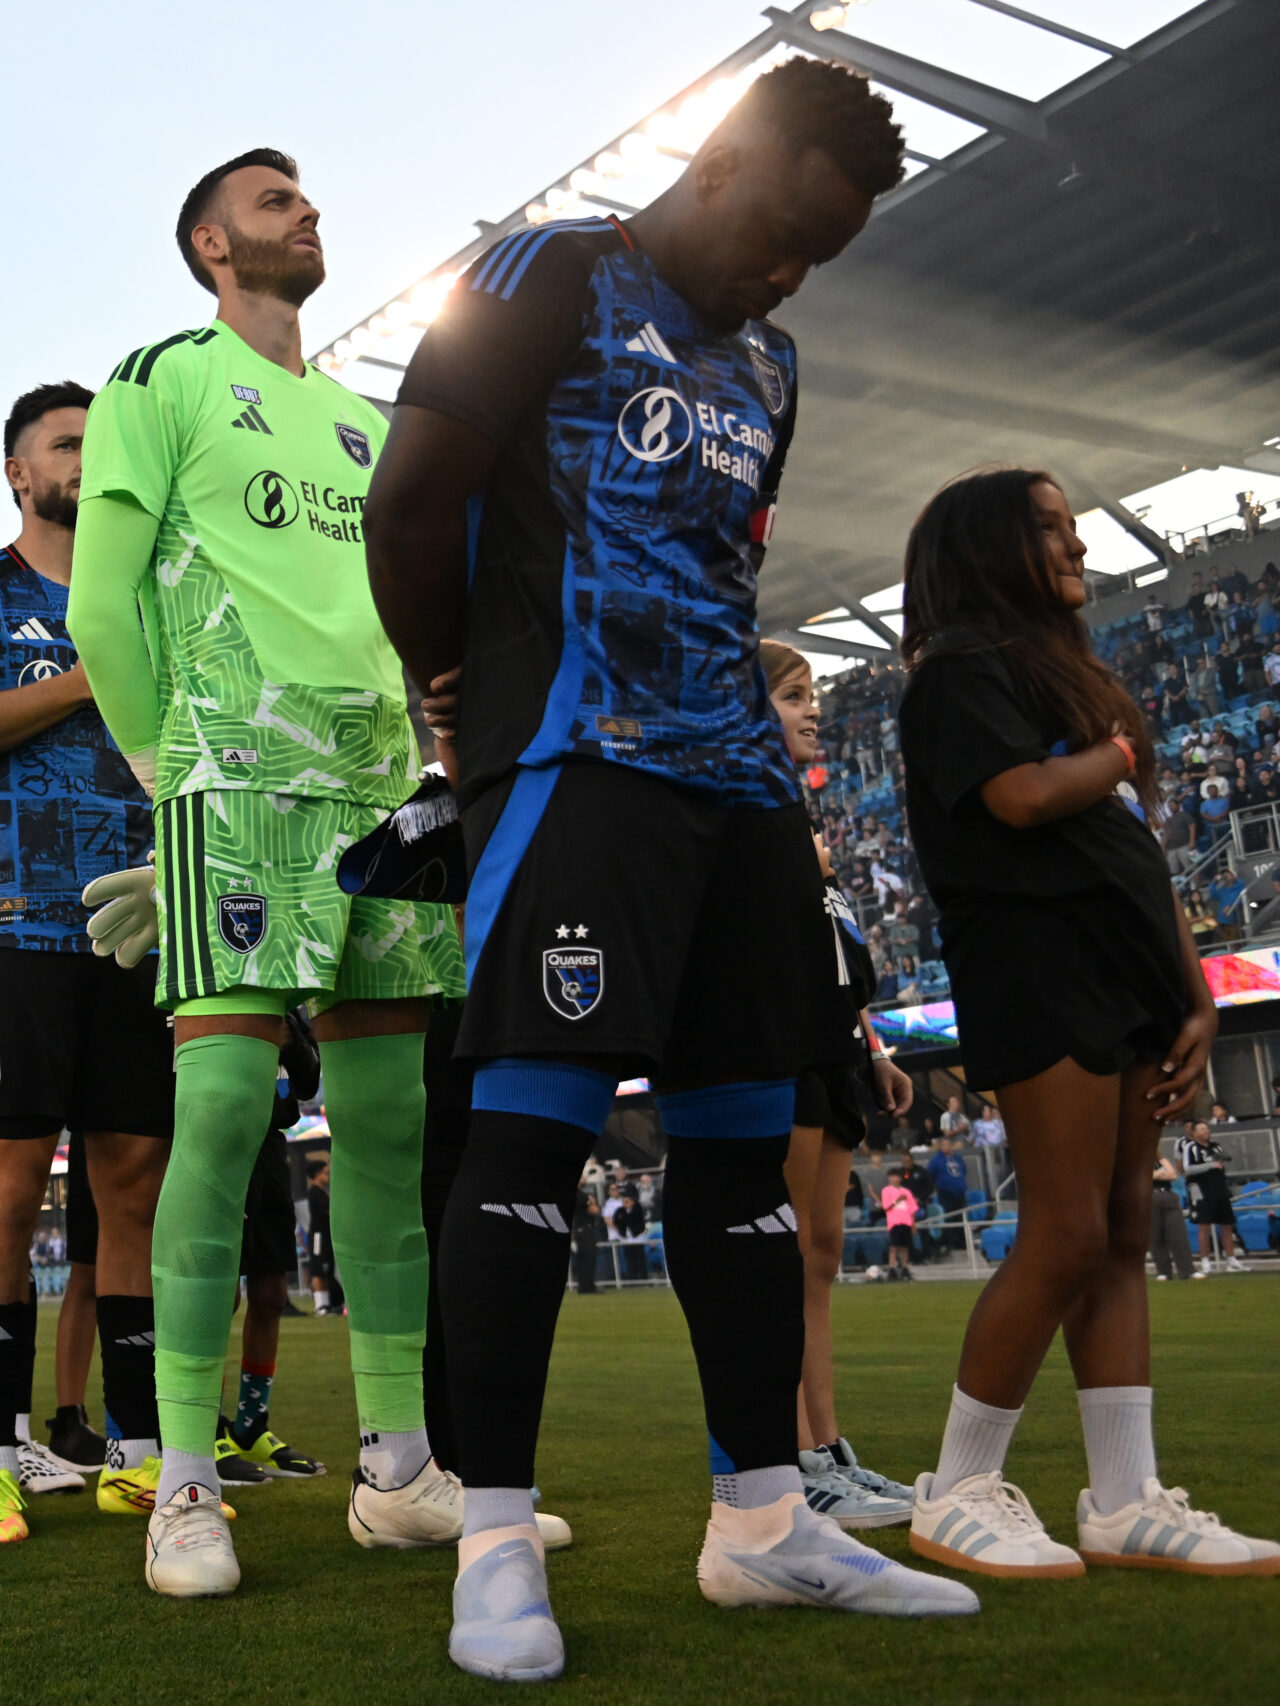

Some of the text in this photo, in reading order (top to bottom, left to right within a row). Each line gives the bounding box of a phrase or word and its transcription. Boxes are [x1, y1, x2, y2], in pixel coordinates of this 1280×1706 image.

[695, 402, 720, 435] El
[701, 437, 760, 492] Health
[300, 480, 320, 507] El
[223, 901, 260, 910] QUAKES
[548, 954, 597, 966] QUAKES
